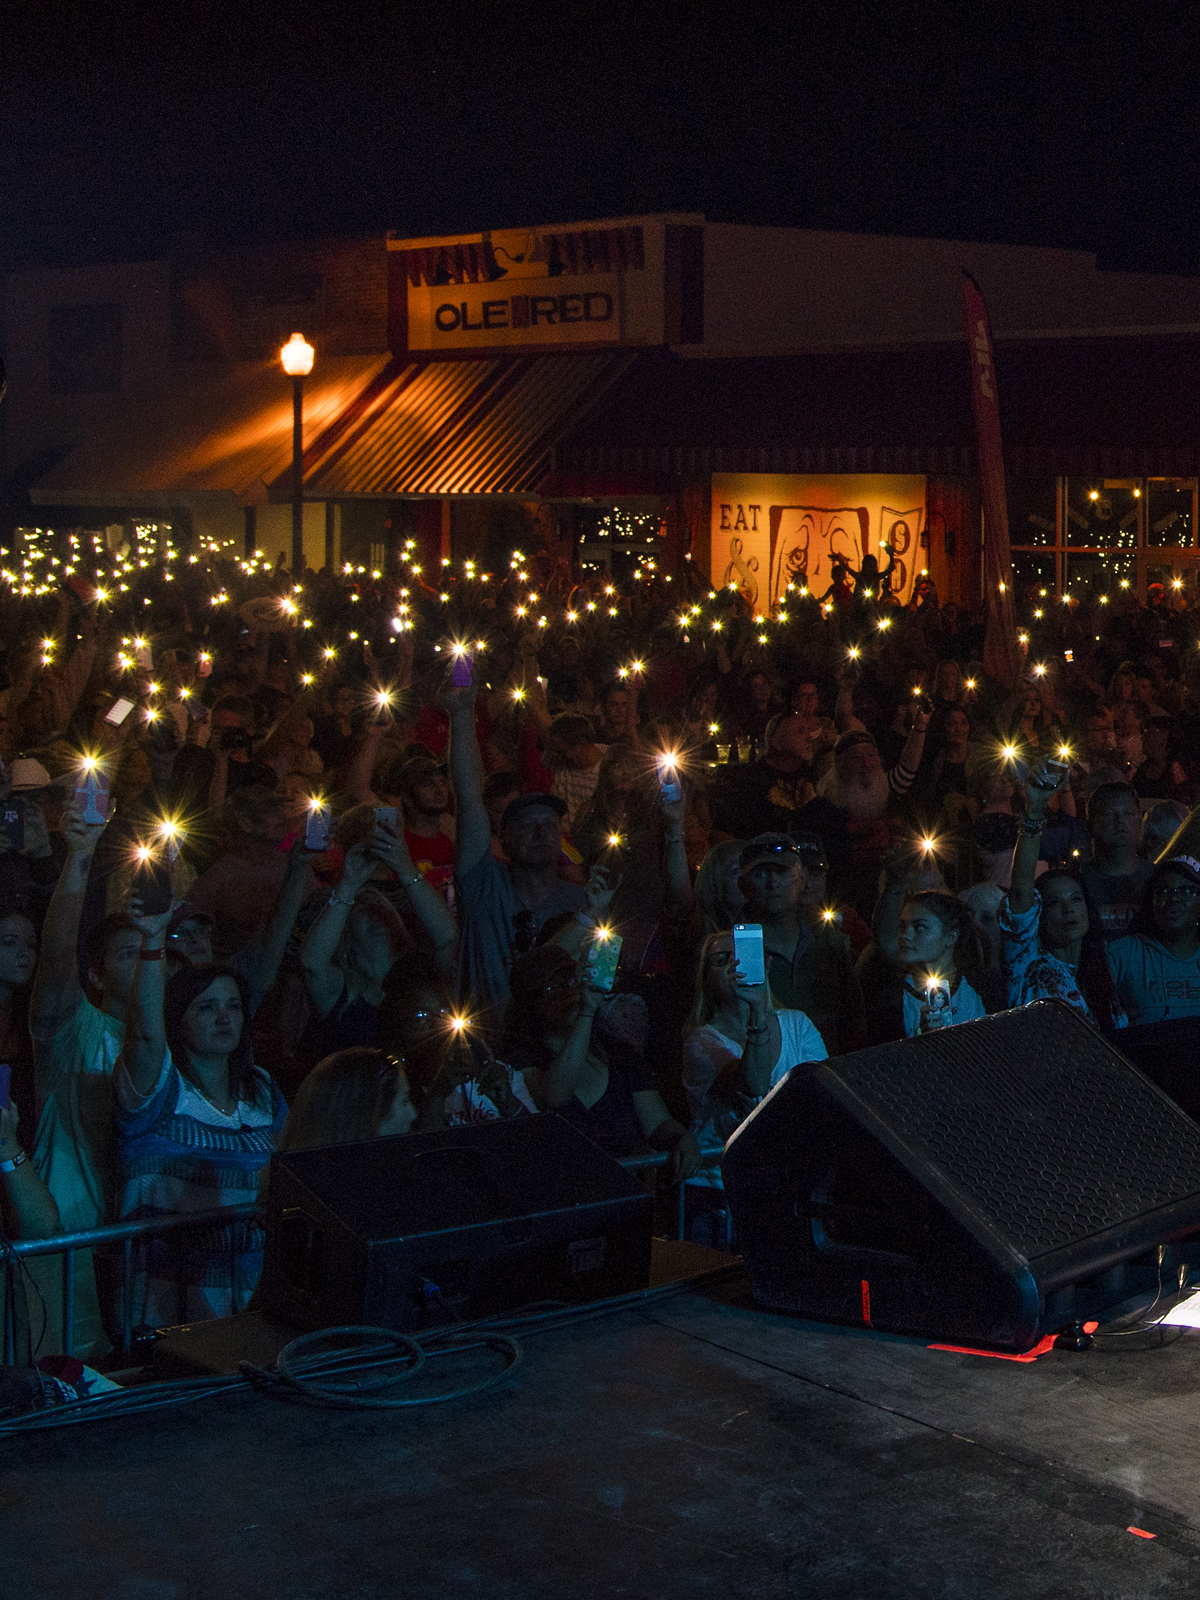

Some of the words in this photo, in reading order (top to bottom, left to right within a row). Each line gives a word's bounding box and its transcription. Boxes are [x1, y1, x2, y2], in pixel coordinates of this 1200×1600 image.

[435, 300, 509, 332] OLE
[530, 292, 614, 326] RED
[719, 504, 761, 531] EAT
